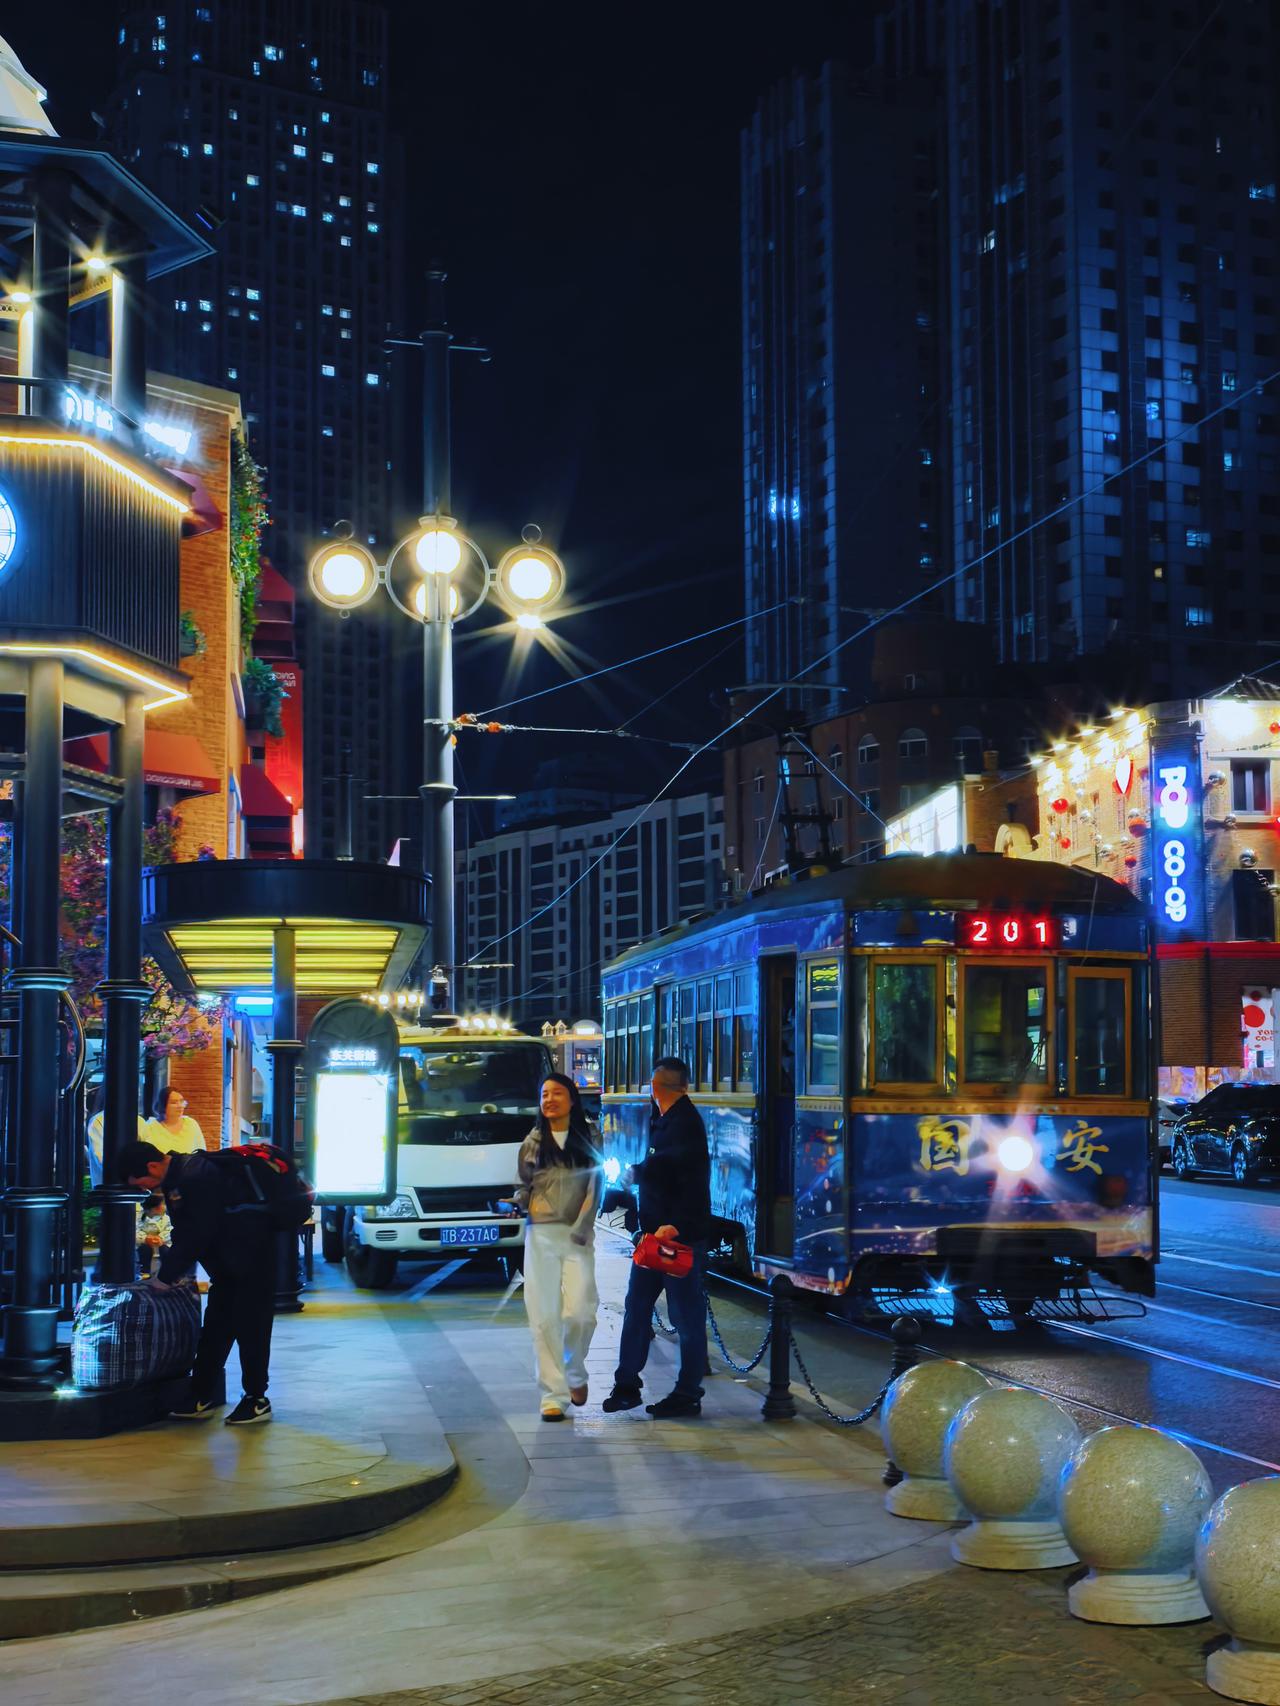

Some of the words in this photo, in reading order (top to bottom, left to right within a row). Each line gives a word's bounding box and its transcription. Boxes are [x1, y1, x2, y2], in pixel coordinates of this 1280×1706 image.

[1159, 766, 1188, 829] POP
[1163, 839, 1187, 922] CO-OP
[973, 920, 1046, 943] 201
